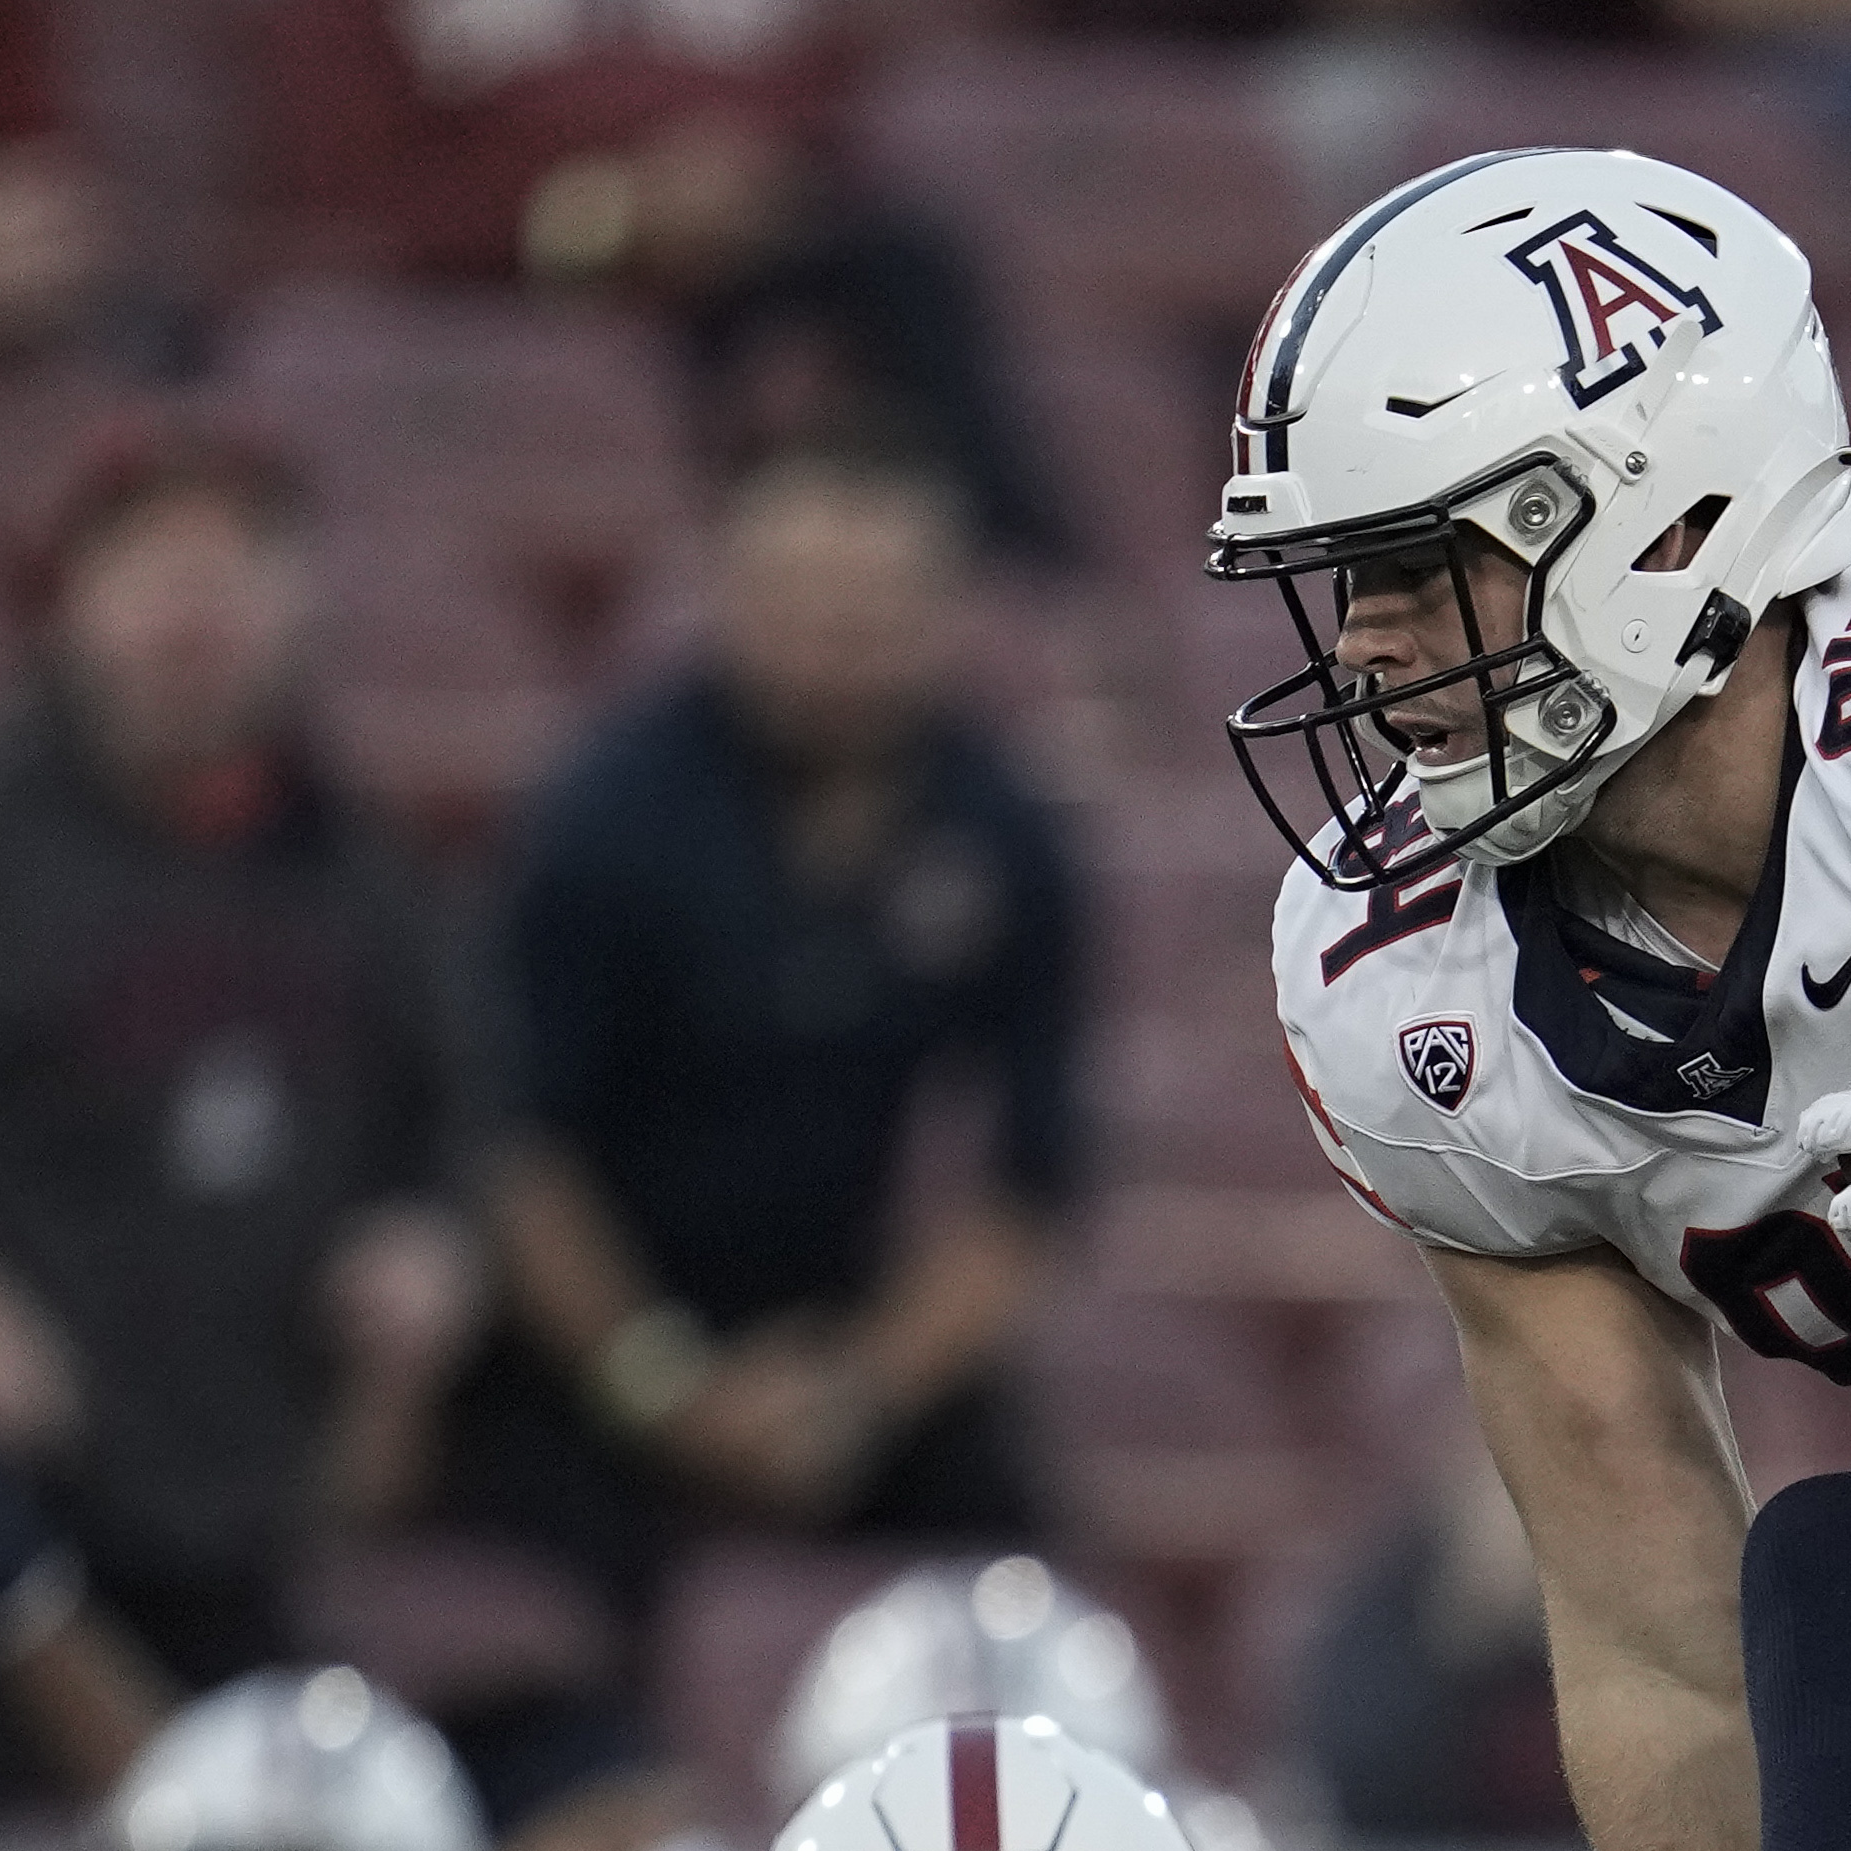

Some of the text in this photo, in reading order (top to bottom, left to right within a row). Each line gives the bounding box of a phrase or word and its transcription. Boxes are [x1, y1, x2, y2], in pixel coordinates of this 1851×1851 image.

[1504, 209, 1724, 411] A
[1403, 1026, 1469, 1080] PAC
[1424, 1061, 1461, 1094] 12
